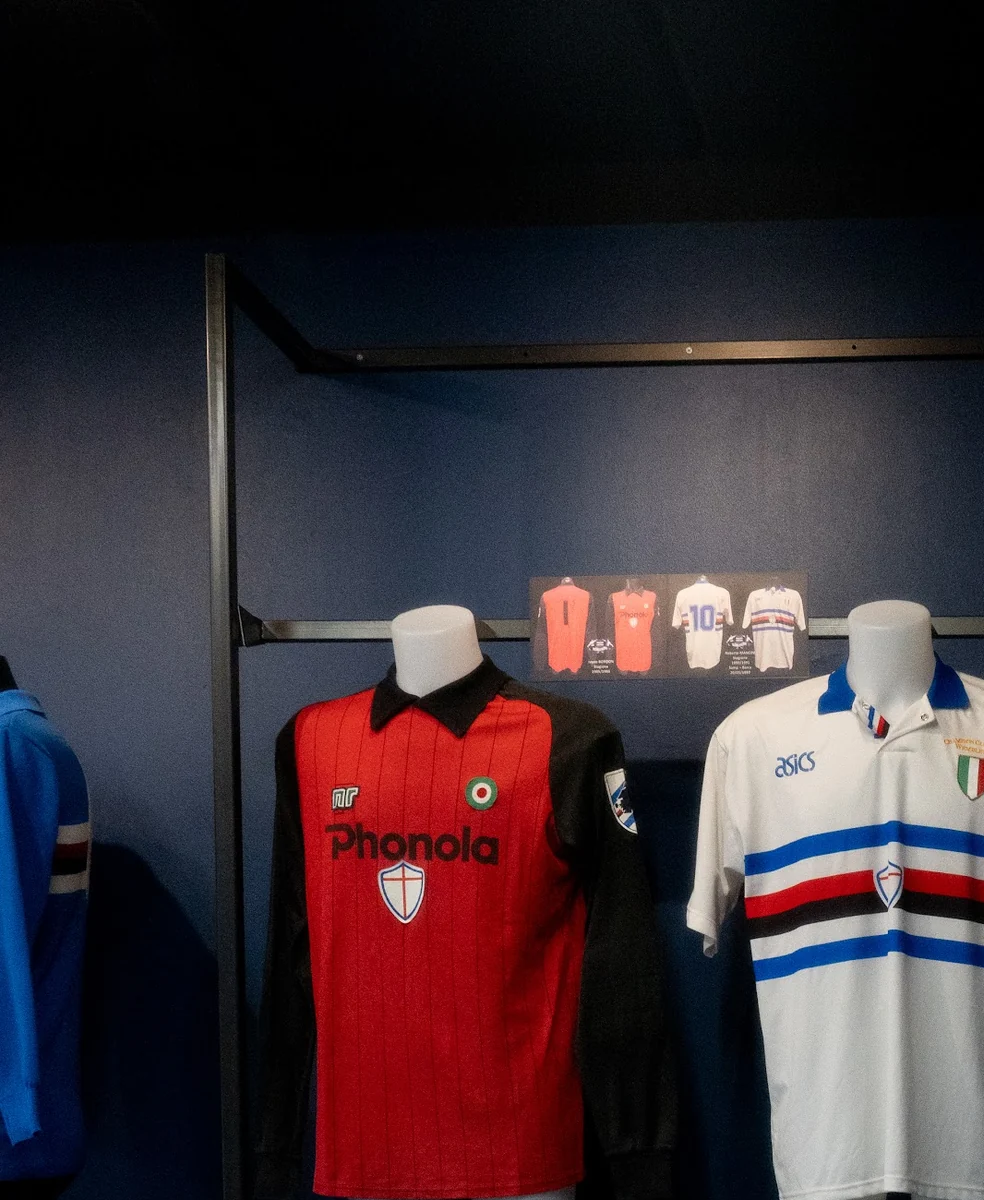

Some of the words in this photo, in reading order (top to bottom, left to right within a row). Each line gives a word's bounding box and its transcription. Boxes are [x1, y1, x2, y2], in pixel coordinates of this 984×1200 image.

[690, 604, 715, 632] 10
[775, 751, 816, 778] asics
[325, 823, 500, 866] Phonola
